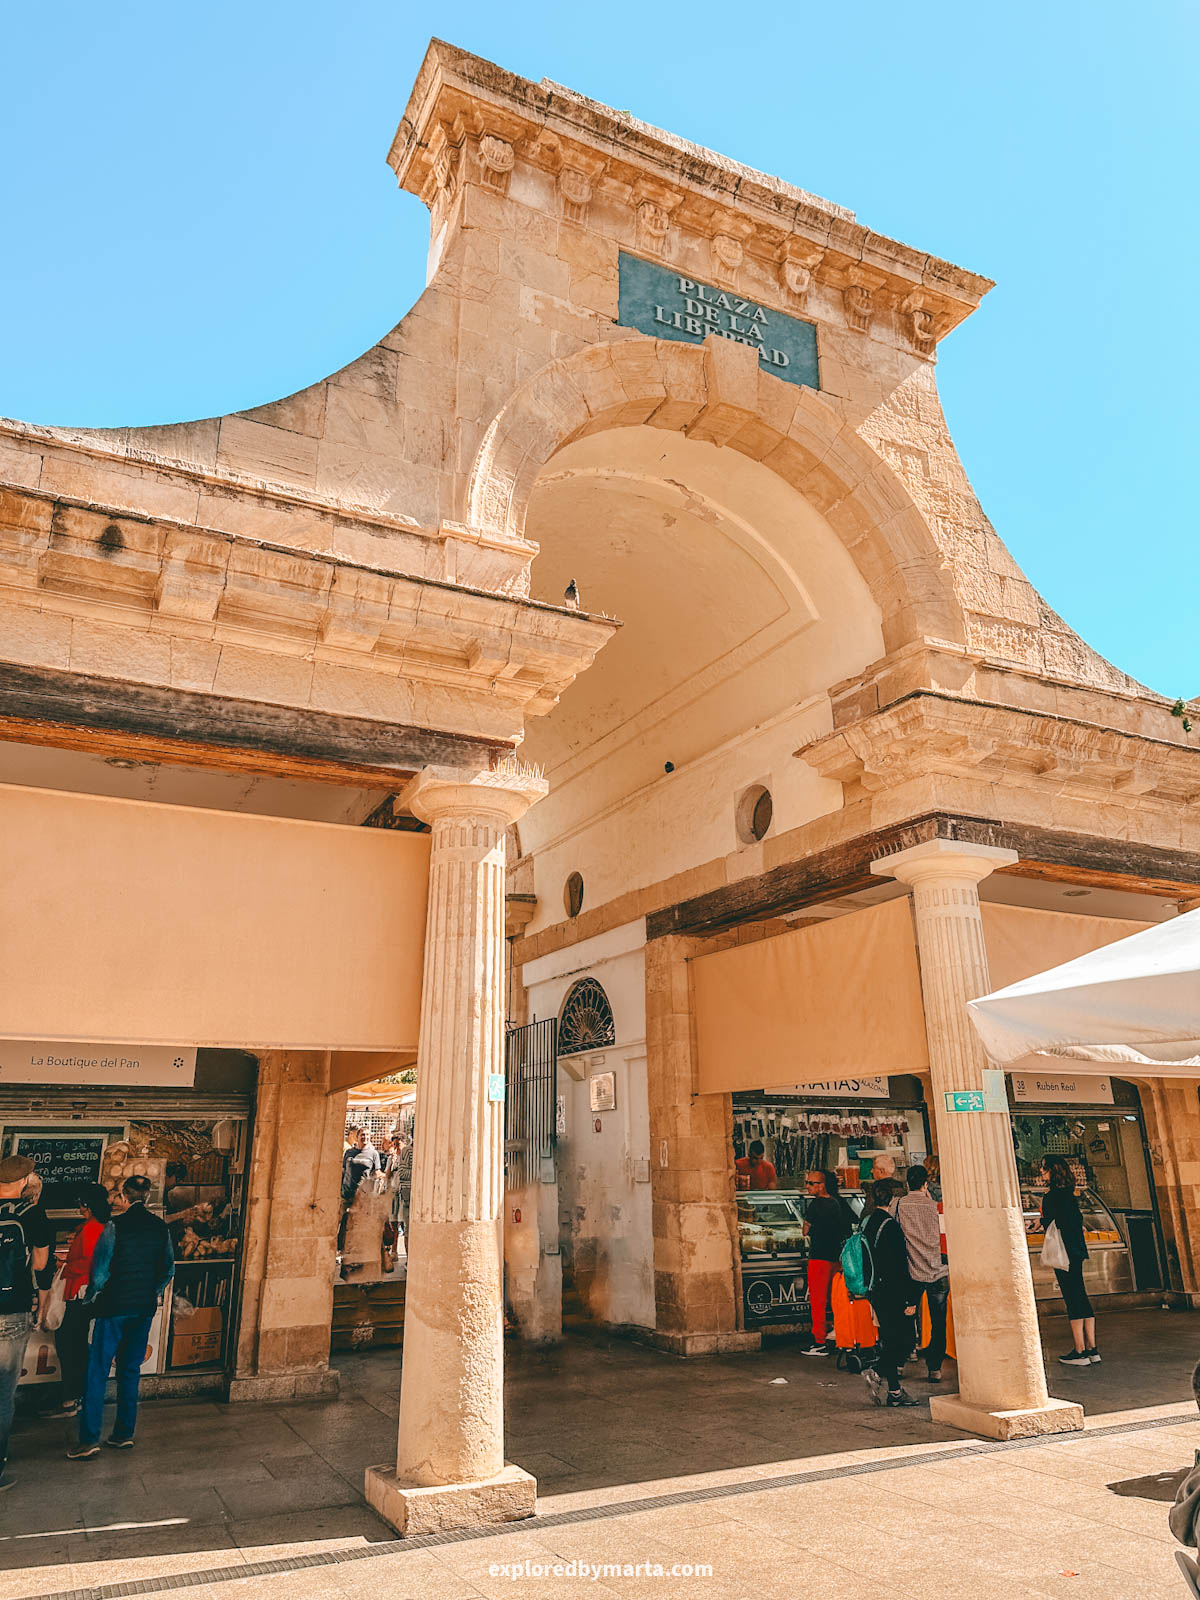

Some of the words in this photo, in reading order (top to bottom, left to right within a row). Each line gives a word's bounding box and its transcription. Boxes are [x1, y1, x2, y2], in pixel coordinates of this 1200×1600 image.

[677, 276, 769, 325] PLAZA
[685, 297, 721, 325] DE
[729, 314, 764, 341] LA
[31, 1056, 43, 1066] La
[47, 1056, 98, 1069] Boutique
[101, 1058, 118, 1068] del
[120, 1059, 140, 1069] Pan
[1016, 1081, 1026, 1090] 38
[1060, 1082, 1076, 1091] Real
